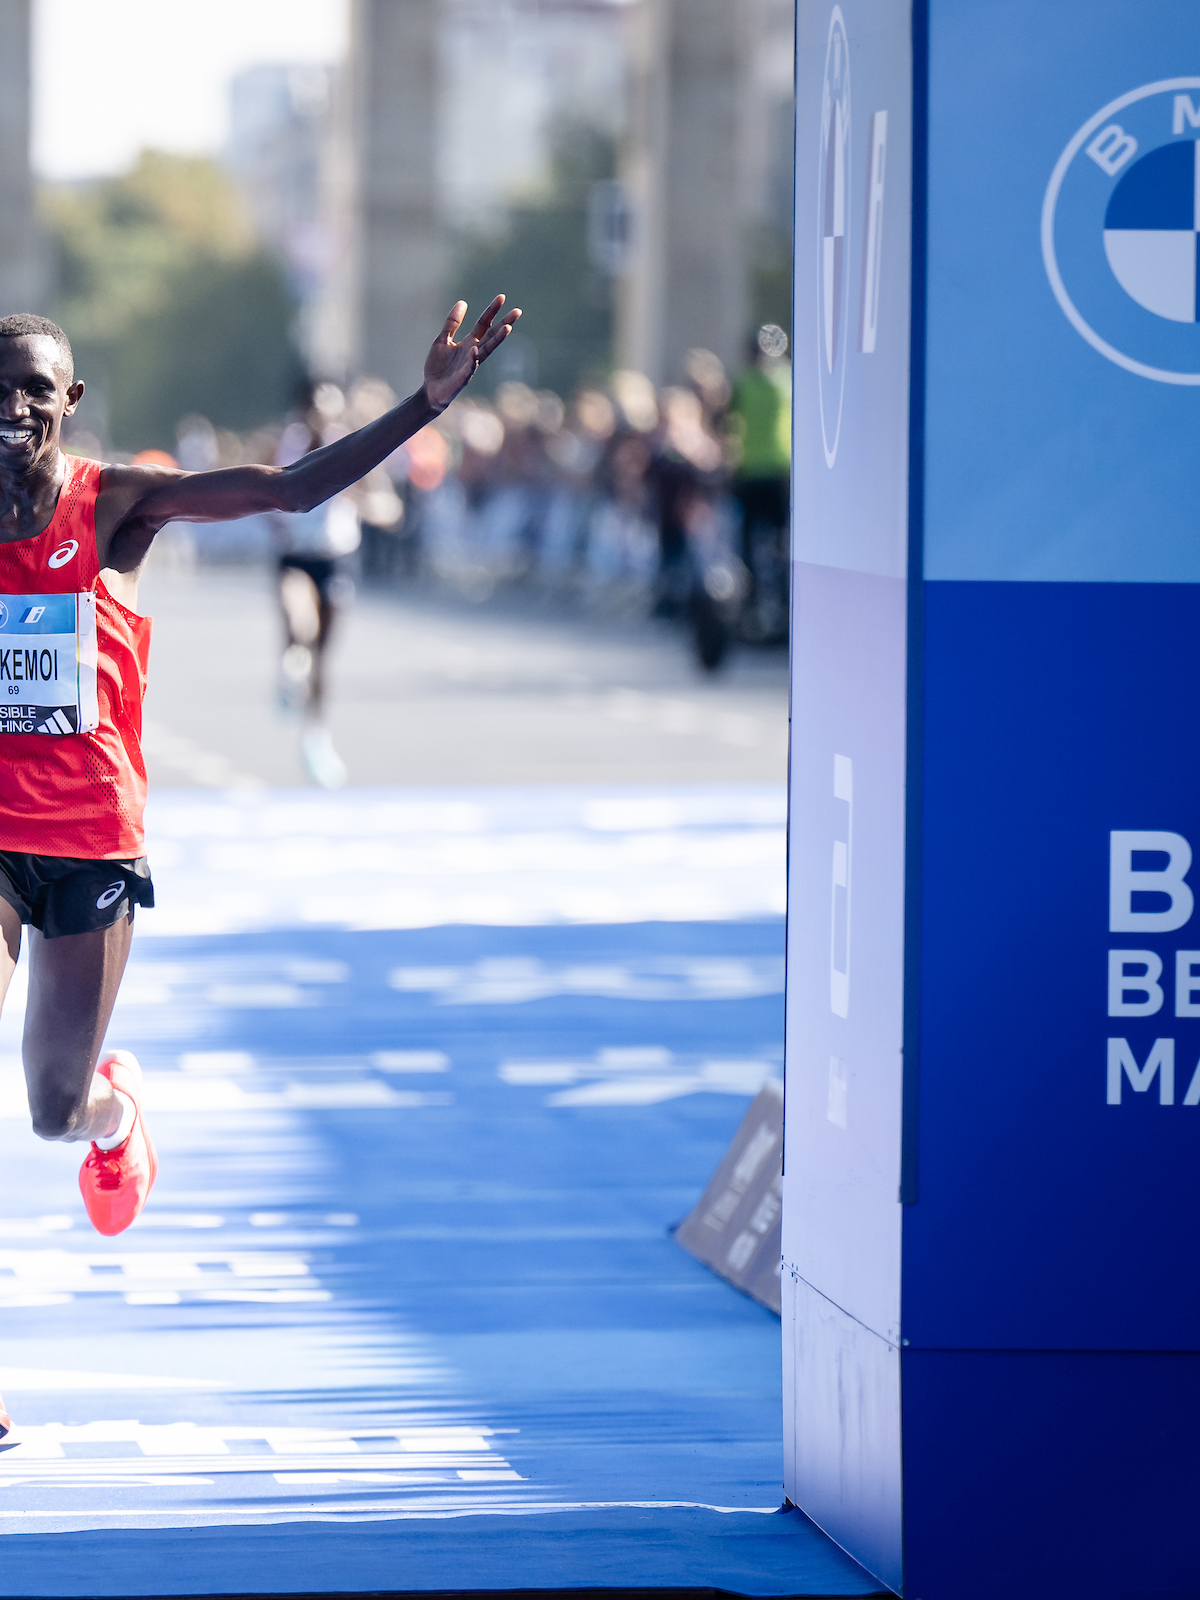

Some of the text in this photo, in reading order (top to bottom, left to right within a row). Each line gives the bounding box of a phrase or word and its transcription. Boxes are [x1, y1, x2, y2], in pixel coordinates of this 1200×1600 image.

[8, 685, 20, 695] 69
[1109, 830, 1195, 933] B
[1106, 1037, 1200, 1106] M
